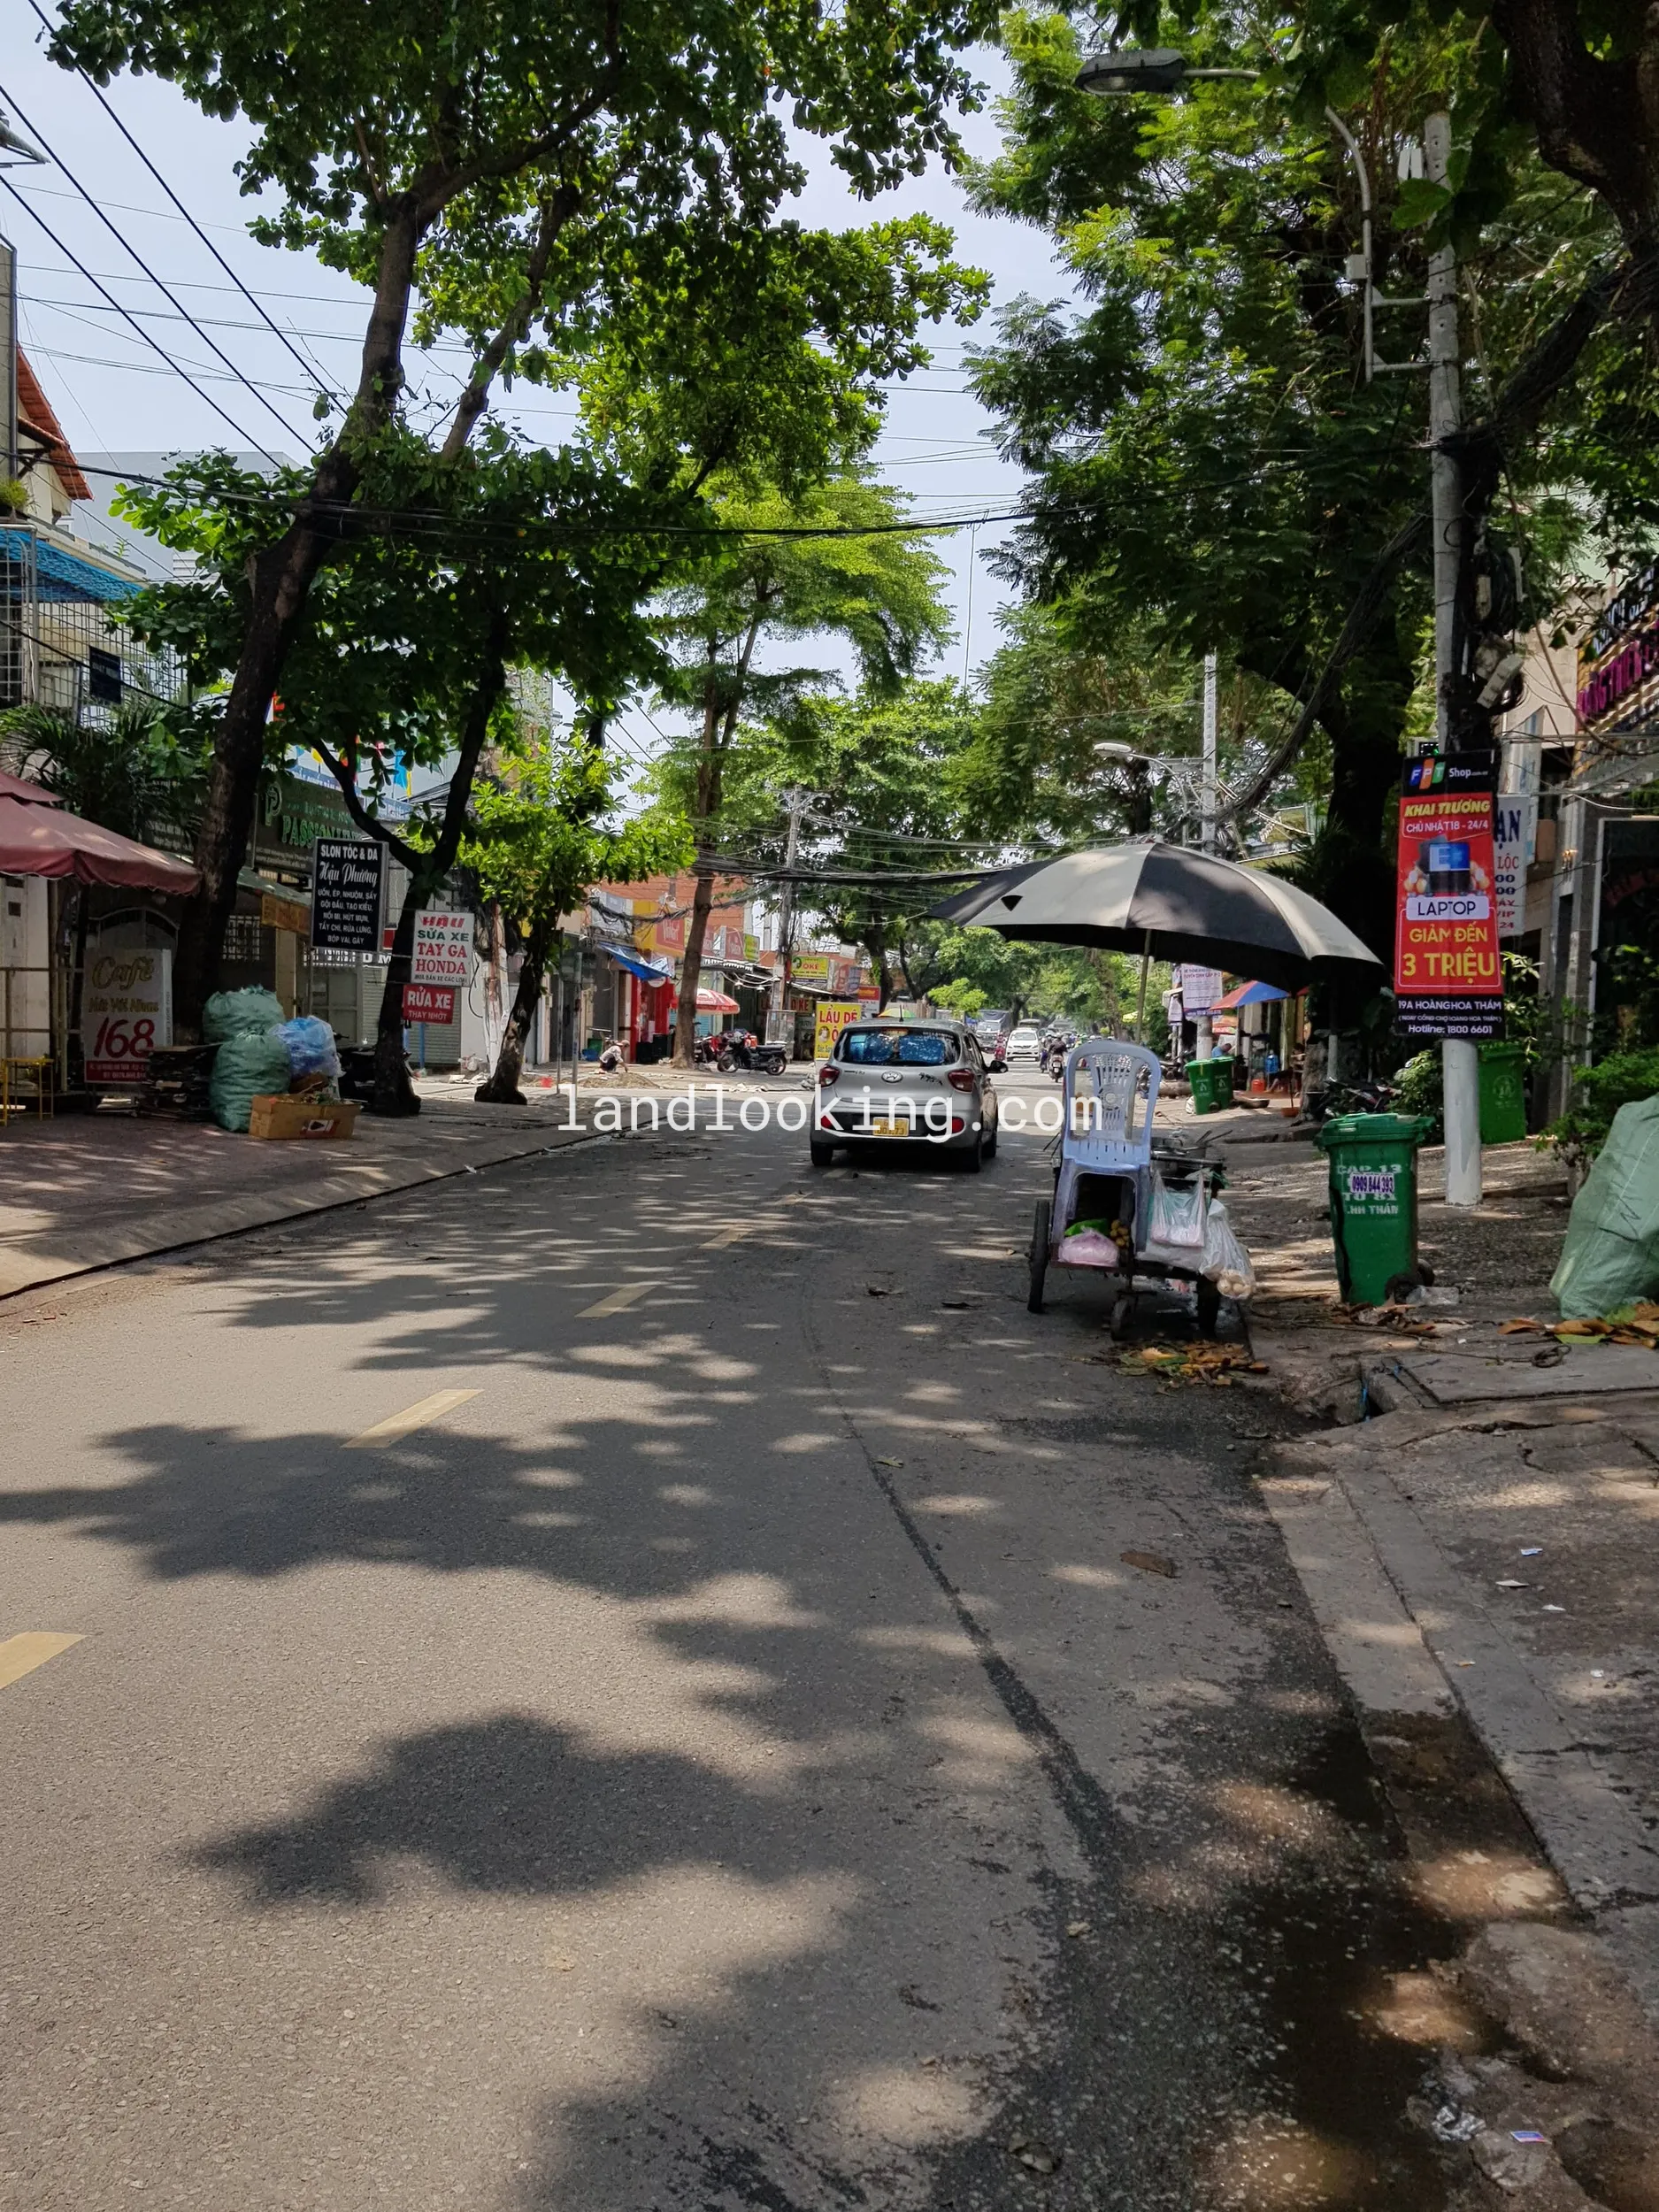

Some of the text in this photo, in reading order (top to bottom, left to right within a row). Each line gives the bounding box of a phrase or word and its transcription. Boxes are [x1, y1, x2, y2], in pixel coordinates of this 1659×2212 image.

[1410, 763, 1445, 784] FPT
[1404, 803, 1435, 817] KHAI
[1406, 820, 1424, 833] CHỦ
[1468, 819, 1488, 830] 24/4
[342, 843, 358, 859] TÓC
[359, 848, 365, 860] &
[367, 848, 379, 861] DA
[1497, 852, 1520, 872] LỘC
[1417, 901, 1476, 916] LAPTOP
[418, 927, 470, 941] SỬA XE
[1454, 921, 1488, 942] ĐẾN
[417, 942, 468, 957] TAY GA
[415, 958, 467, 974] HONDA
[1402, 946, 1495, 984] 3 TRIỆU
[407, 986, 452, 1010] RỬA XE
[1398, 1001, 1413, 1010] 19A
[1475, 999, 1502, 1010] THÁM
[408, 1010, 427, 1019] THAY
[1409, 1025, 1493, 1034] Hotline: 1800 6601
[94, 1017, 155, 1058] 168
